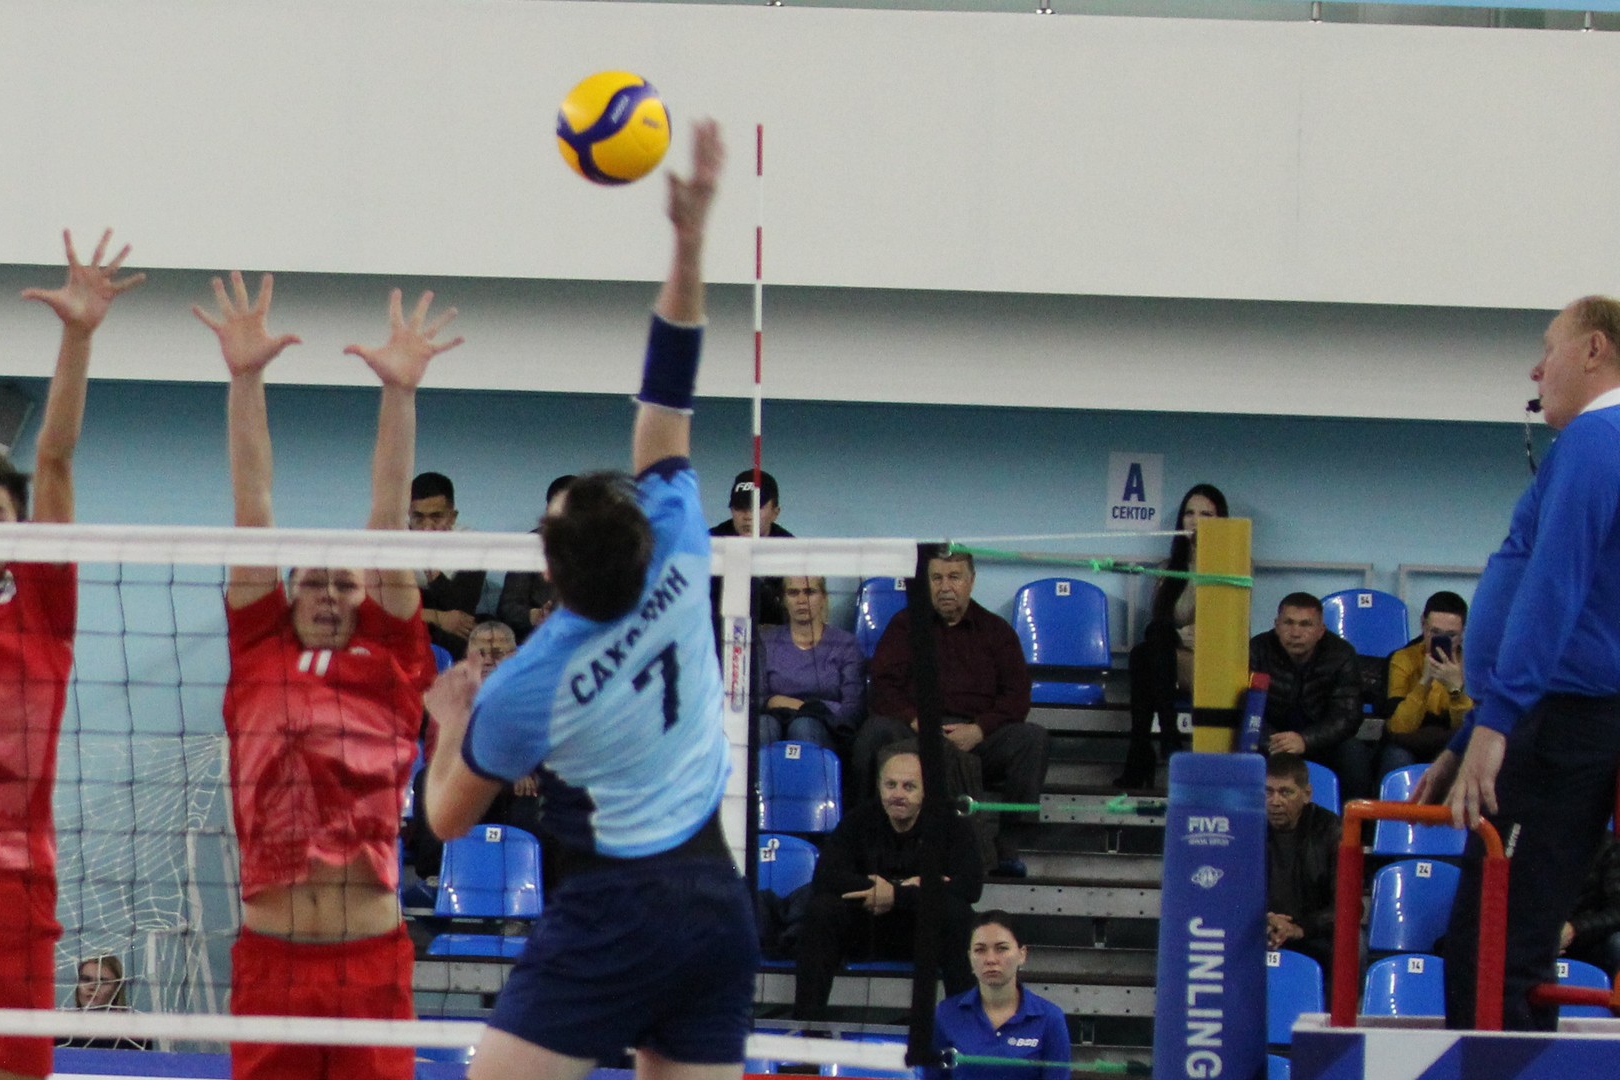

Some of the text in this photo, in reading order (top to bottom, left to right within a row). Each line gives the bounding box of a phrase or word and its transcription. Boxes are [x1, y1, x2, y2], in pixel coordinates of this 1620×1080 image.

[1122, 463, 1146, 502] А
[1111, 506, 1156, 520] СЕКТОР
[298, 649, 333, 677] 11
[632, 640, 679, 734] 7
[1188, 816, 1229, 832] FIVB
[1185, 917, 1226, 1080] JINLING
